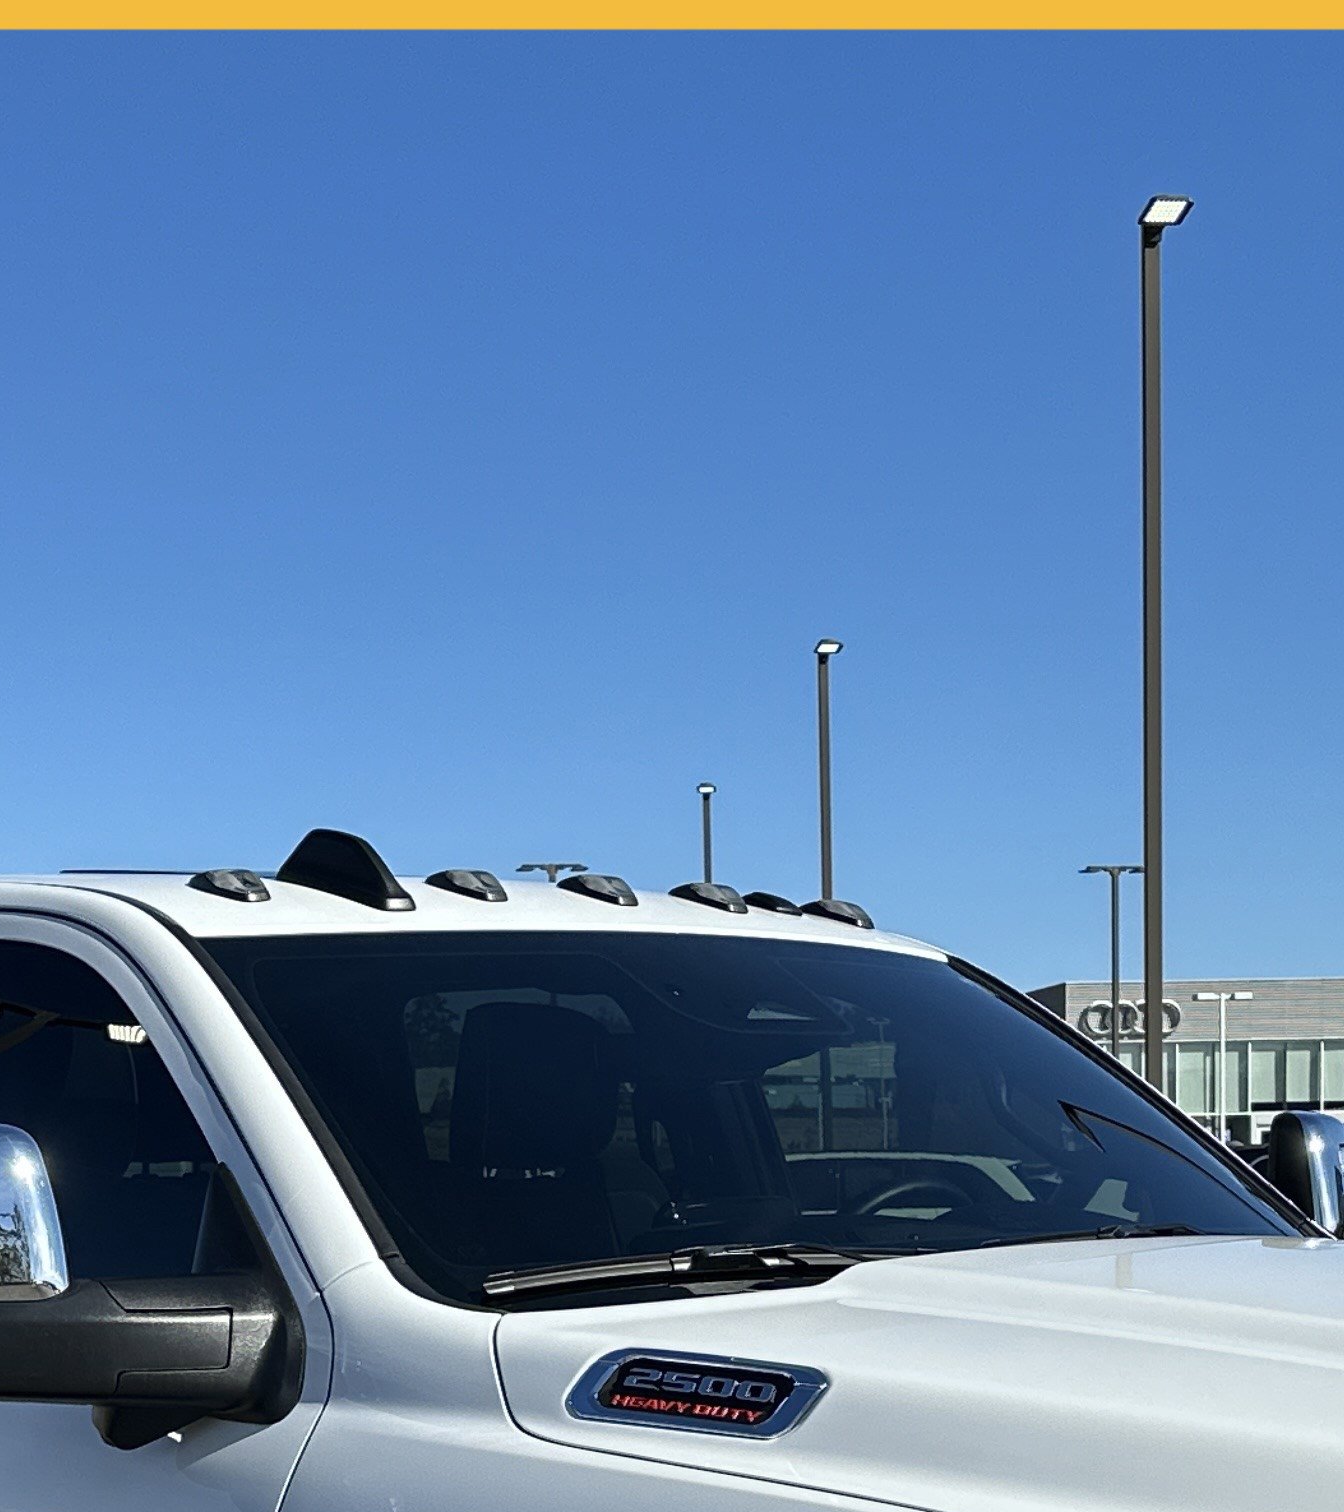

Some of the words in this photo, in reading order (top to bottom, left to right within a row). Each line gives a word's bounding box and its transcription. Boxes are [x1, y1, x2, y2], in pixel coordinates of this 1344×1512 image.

[621, 1366, 778, 1404] 2500
[610, 1394, 690, 1414] HEAVY
[693, 1403, 764, 1424] DUTY
